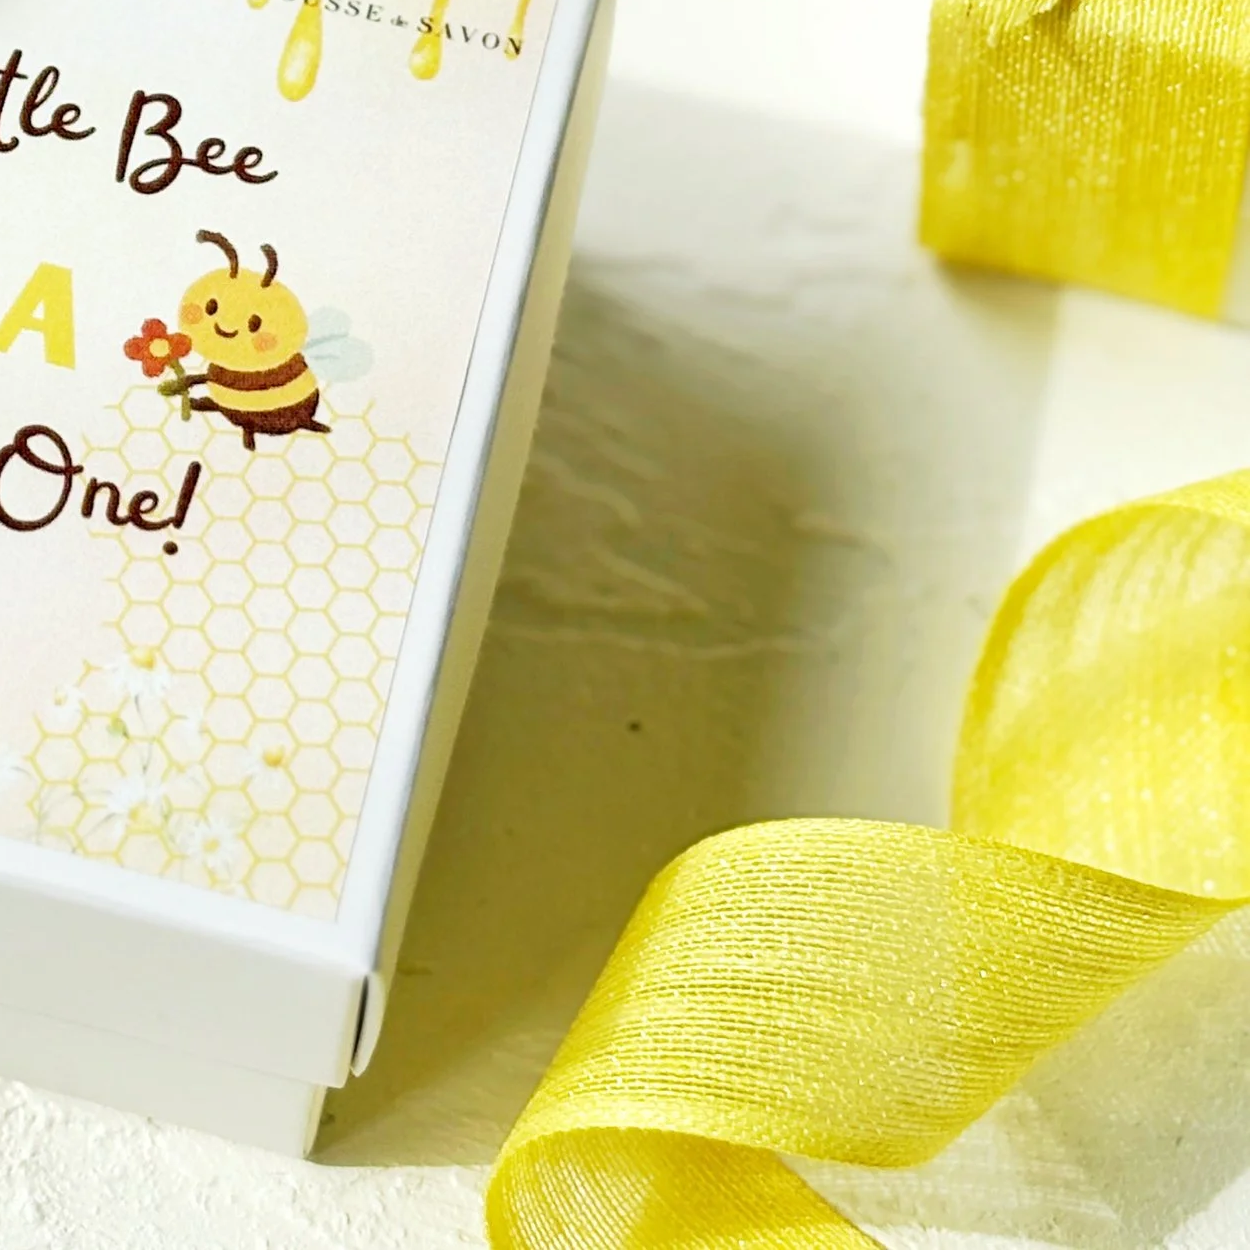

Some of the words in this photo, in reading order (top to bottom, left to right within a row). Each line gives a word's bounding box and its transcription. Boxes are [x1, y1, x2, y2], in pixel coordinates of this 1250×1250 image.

[390, 15, 409, 28] de
[417, 16, 523, 56] SAVON
[115, 90, 279, 195] Bee
